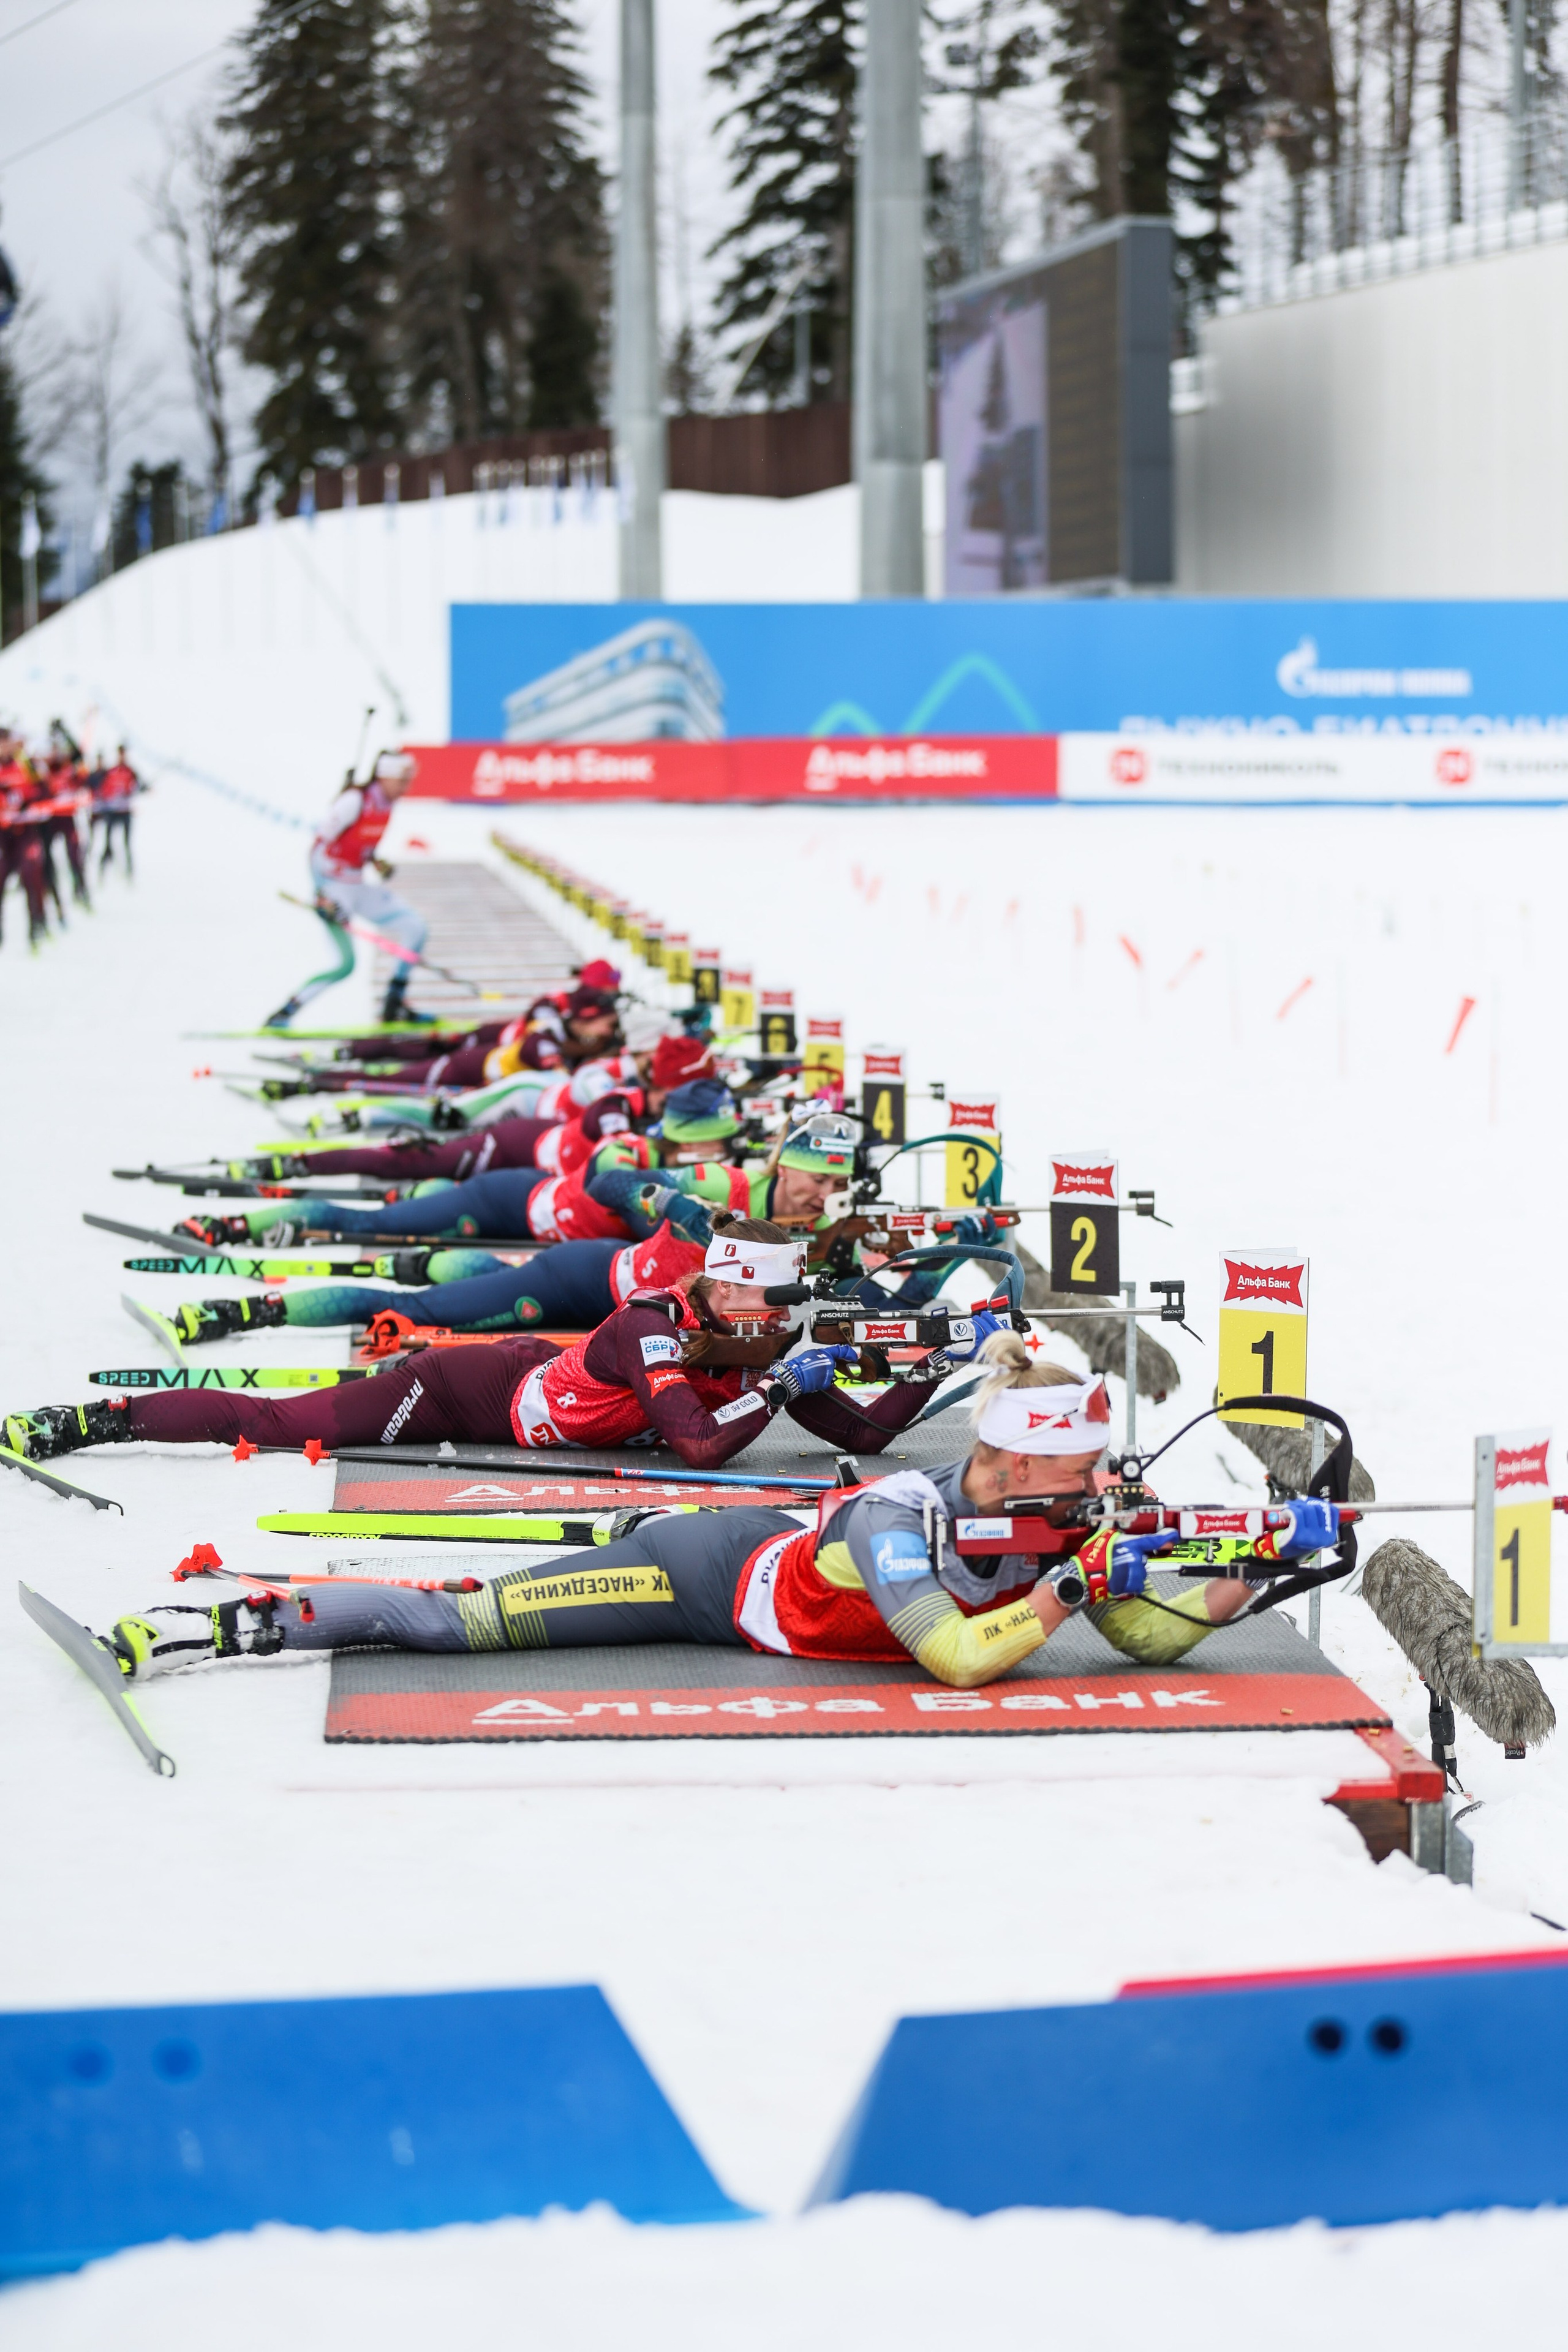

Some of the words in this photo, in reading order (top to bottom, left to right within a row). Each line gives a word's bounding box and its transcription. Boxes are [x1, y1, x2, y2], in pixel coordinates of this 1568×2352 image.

[873, 1090, 893, 1139] 4
[962, 1147, 979, 1199] 3
[1062, 1173, 1086, 1186] Альфа
[1087, 1174, 1105, 1185] Банк
[1071, 1216, 1097, 1283] 2
[130, 1259, 174, 1272] SPEED
[178, 1257, 265, 1276] MAX
[1237, 1275, 1267, 1290] Альфа
[1268, 1277, 1291, 1289] Банк
[645, 1344, 668, 1353] СБР
[1251, 1330, 1274, 1395] 1
[98, 1371, 150, 1385] SPEED
[156, 1369, 261, 1388] MAX
[654, 1373, 674, 1389] Альфа
[557, 1392, 577, 1409] 8
[740, 1395, 758, 1408] GOLD
[1496, 1460, 1520, 1479] Альфа
[1520, 1457, 1540, 1471] Банк
[445, 1484, 766, 1502] Альфа
[1202, 1519, 1224, 1529] Альфа
[1501, 1528, 1519, 1626] 1
[510, 1576, 645, 1601] «НАСЕДКИНА»
[472, 1697, 885, 1724] Альфа
[911, 1690, 1225, 1712] Банк
